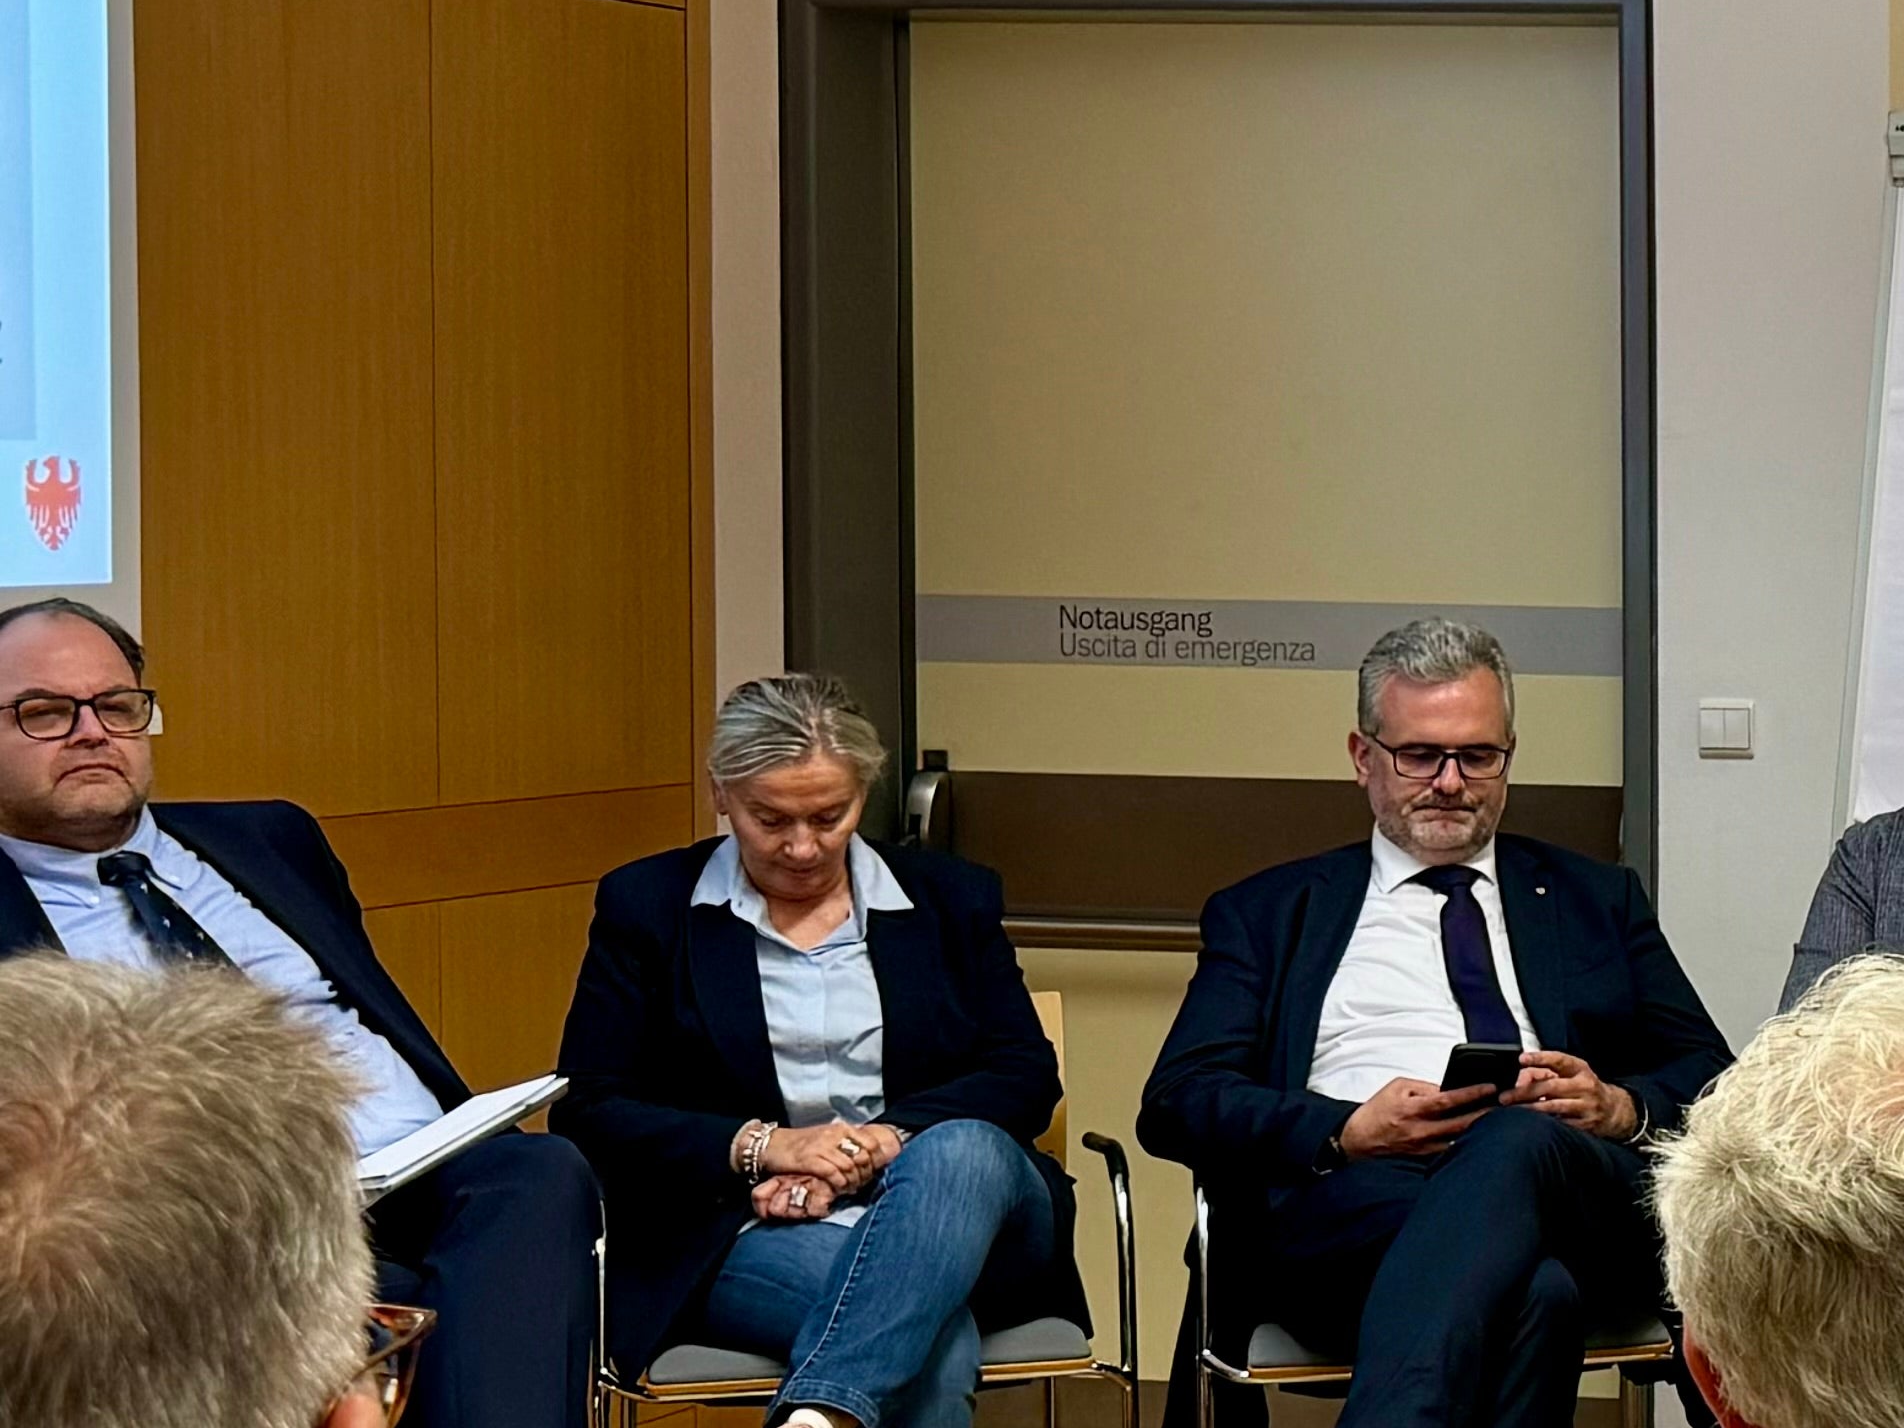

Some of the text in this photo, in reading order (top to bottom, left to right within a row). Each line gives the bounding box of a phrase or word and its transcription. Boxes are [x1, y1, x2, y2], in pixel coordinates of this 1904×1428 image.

[1059, 604, 1213, 637] Notausgang
[1060, 632, 1315, 667] Uscita di emergenza
